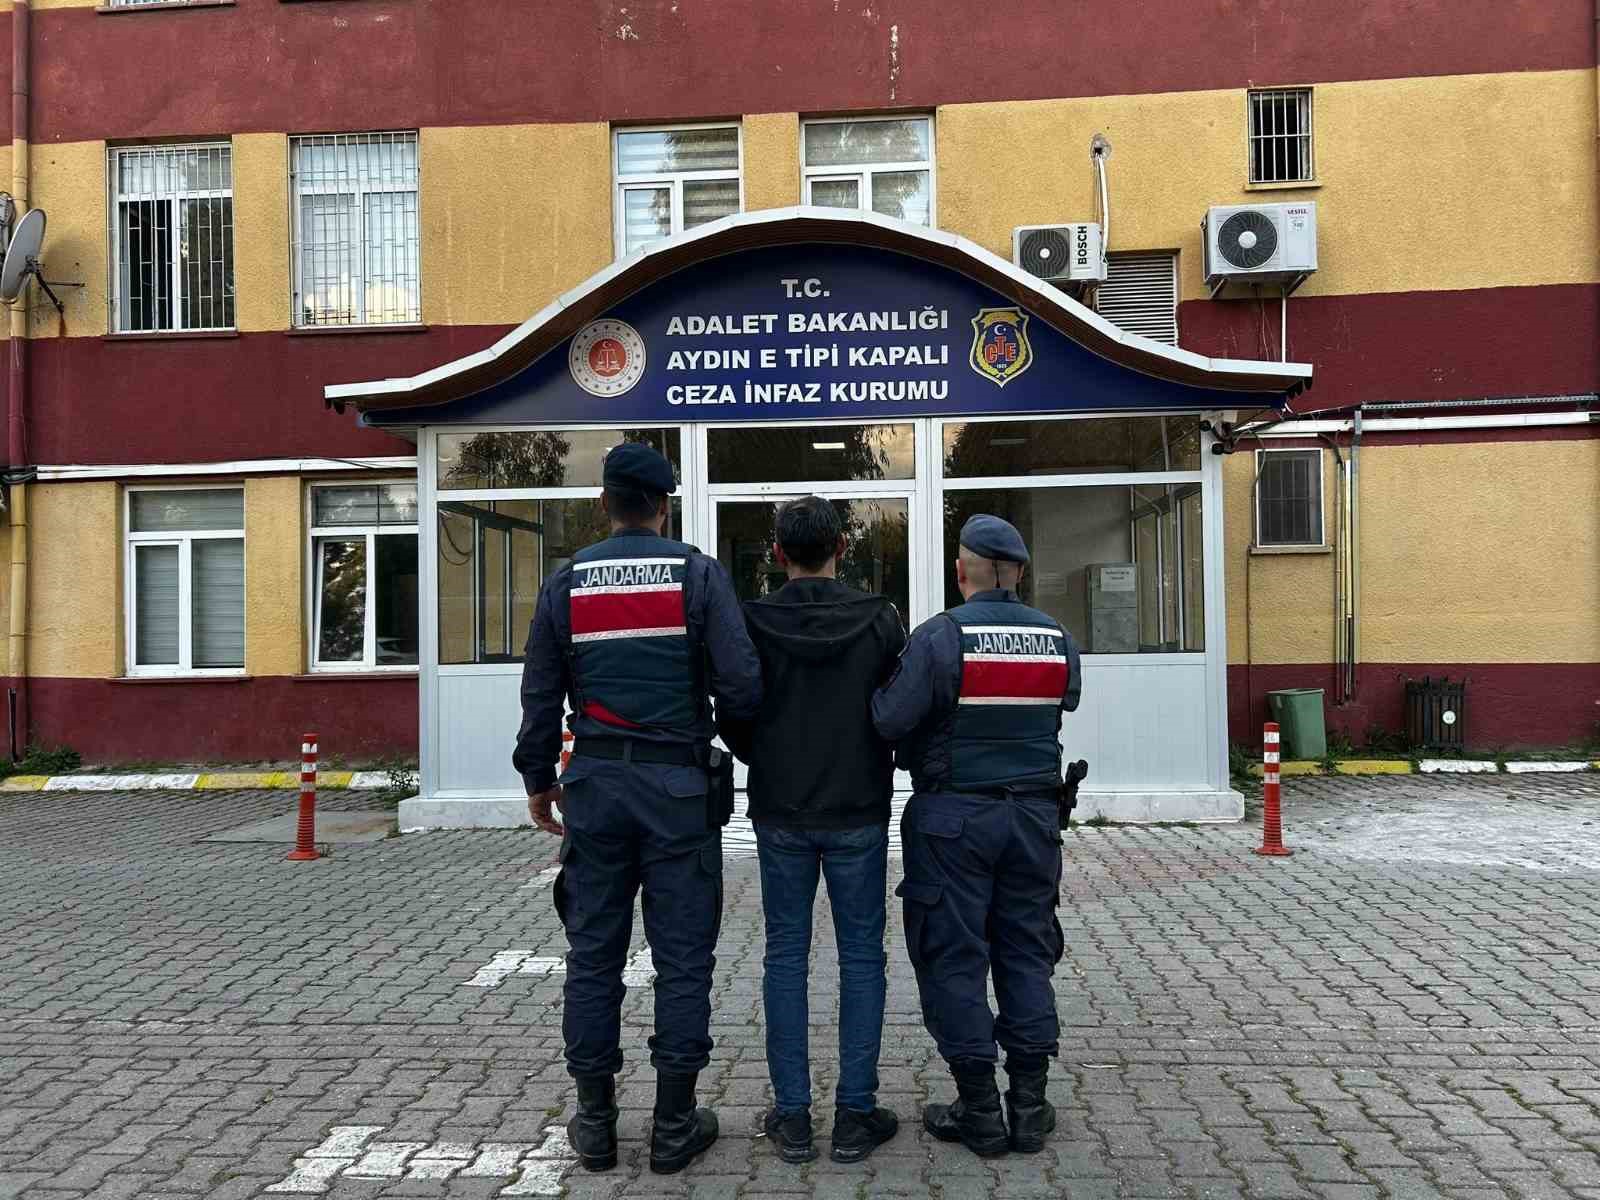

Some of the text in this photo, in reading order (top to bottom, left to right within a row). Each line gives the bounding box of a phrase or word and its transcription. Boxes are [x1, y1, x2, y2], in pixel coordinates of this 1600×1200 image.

[1077, 225, 1088, 266] BOSCH
[782, 279, 831, 298] T.C.
[665, 305, 949, 336] ADALET BAKANLIĞI
[666, 343, 949, 371] AYDIN E TİPİ KAPALI
[985, 336, 1017, 363] CTE
[666, 379, 949, 405] CEZA İNFAZ KURUMU
[581, 565, 673, 587] JANDARMA
[974, 633, 1058, 655] JANDARMA
